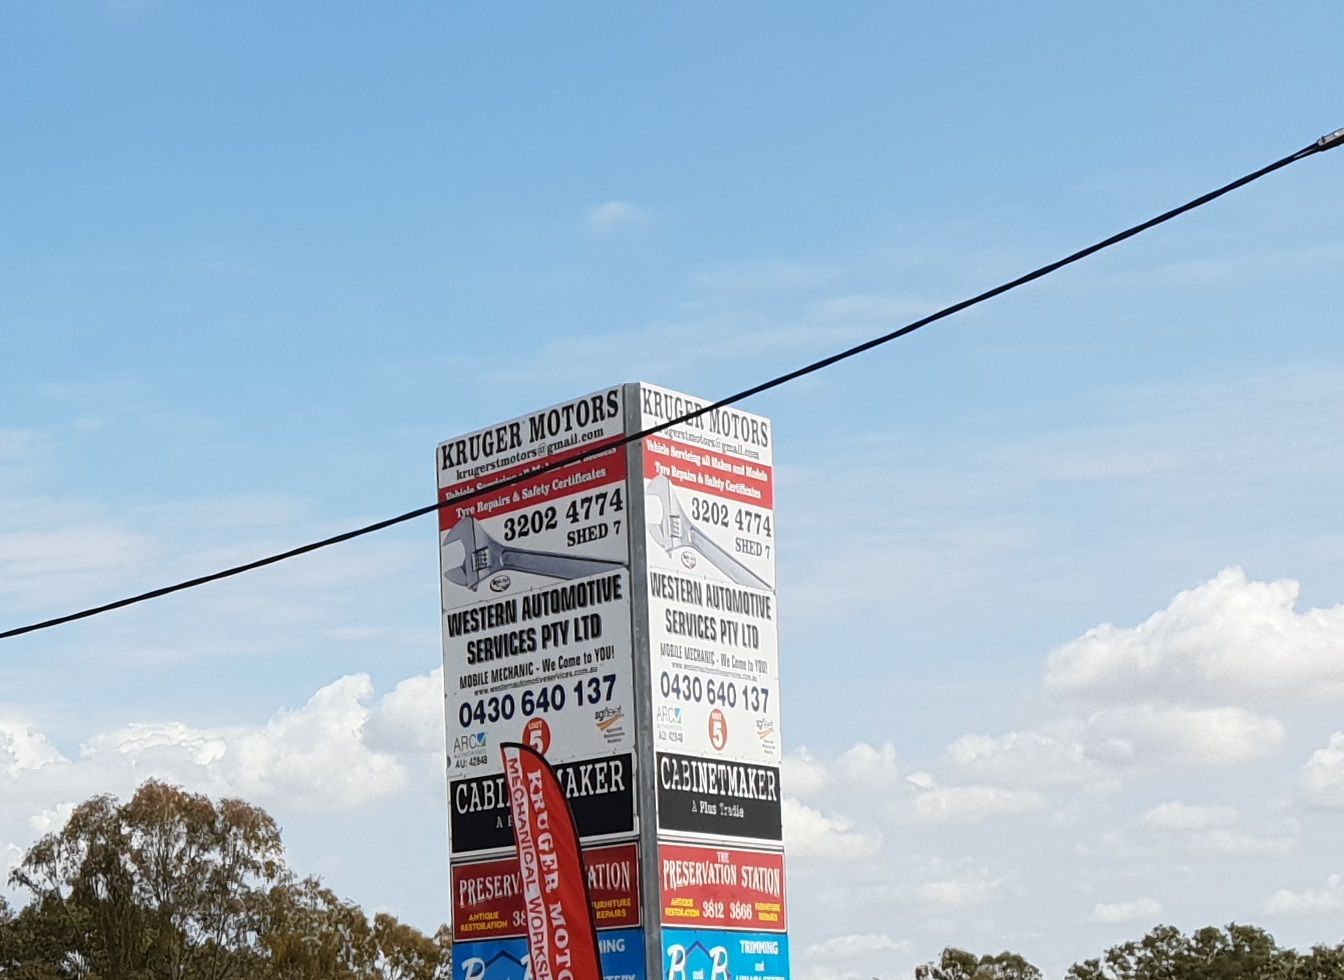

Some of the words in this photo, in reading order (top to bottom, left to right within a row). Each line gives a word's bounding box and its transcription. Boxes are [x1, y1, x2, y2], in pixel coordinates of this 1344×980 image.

[441, 422, 522, 470] KRUGER
[529, 389, 619, 442] MOTORS
[642, 388, 704, 431] KRUGER
[709, 407, 768, 447] MOTORS
[456, 428, 604, 480] krugerstmotors@gmail.com
[477, 495, 510, 514] Repairs
[512, 491, 520, 503] &
[521, 482, 551, 500] Safety
[552, 467, 607, 490] Certificates
[504, 507, 557, 541] 3202
[566, 488, 623, 524] 4774
[567, 522, 608, 547] SHED
[613, 520, 621, 535] 7
[691, 497, 729, 528] 3202
[735, 508, 772, 538] 4774
[735, 537, 762, 556] SHED
[765, 545, 771, 560] 7
[447, 599, 517, 638] WESTERN
[521, 574, 623, 621] AUTOMOTIVE
[650, 571, 702, 608] WESTERN
[706, 583, 772, 621] AUTOMOTIVE
[467, 628, 537, 665] SERVICES
[541, 620, 570, 650] PTY
[573, 613, 602, 642] LTD
[665, 608, 717, 642] SERVICES
[720, 619, 740, 648] PTY
[742, 622, 759, 650] LTD
[459, 671, 488, 690] MOBILE
[491, 663, 534, 683] MECHANIC
[542, 659, 556, 672] We
[558, 654, 580, 670] Come
[583, 652, 592, 664] to
[594, 645, 615, 662] YOU!
[459, 694, 514, 728] 0430
[521, 684, 565, 716] 640
[573, 674, 616, 706] 137
[660, 671, 702, 703] 0430
[706, 679, 737, 709] 640
[742, 685, 769, 714] 137
[528, 729, 543, 751] 5
[712, 720, 723, 748] 5
[661, 757, 777, 801] CABINETMAKER
[507, 758, 537, 892] MECHANICAL
[691, 800, 698, 813] A
[699, 800, 717, 815] Plus
[527, 769, 559, 893] KRUGER
[459, 872, 522, 908] PRESERV
[663, 859, 737, 891] PRESERVATION
[741, 866, 780, 897] STATION
[702, 898, 725, 919] 3812
